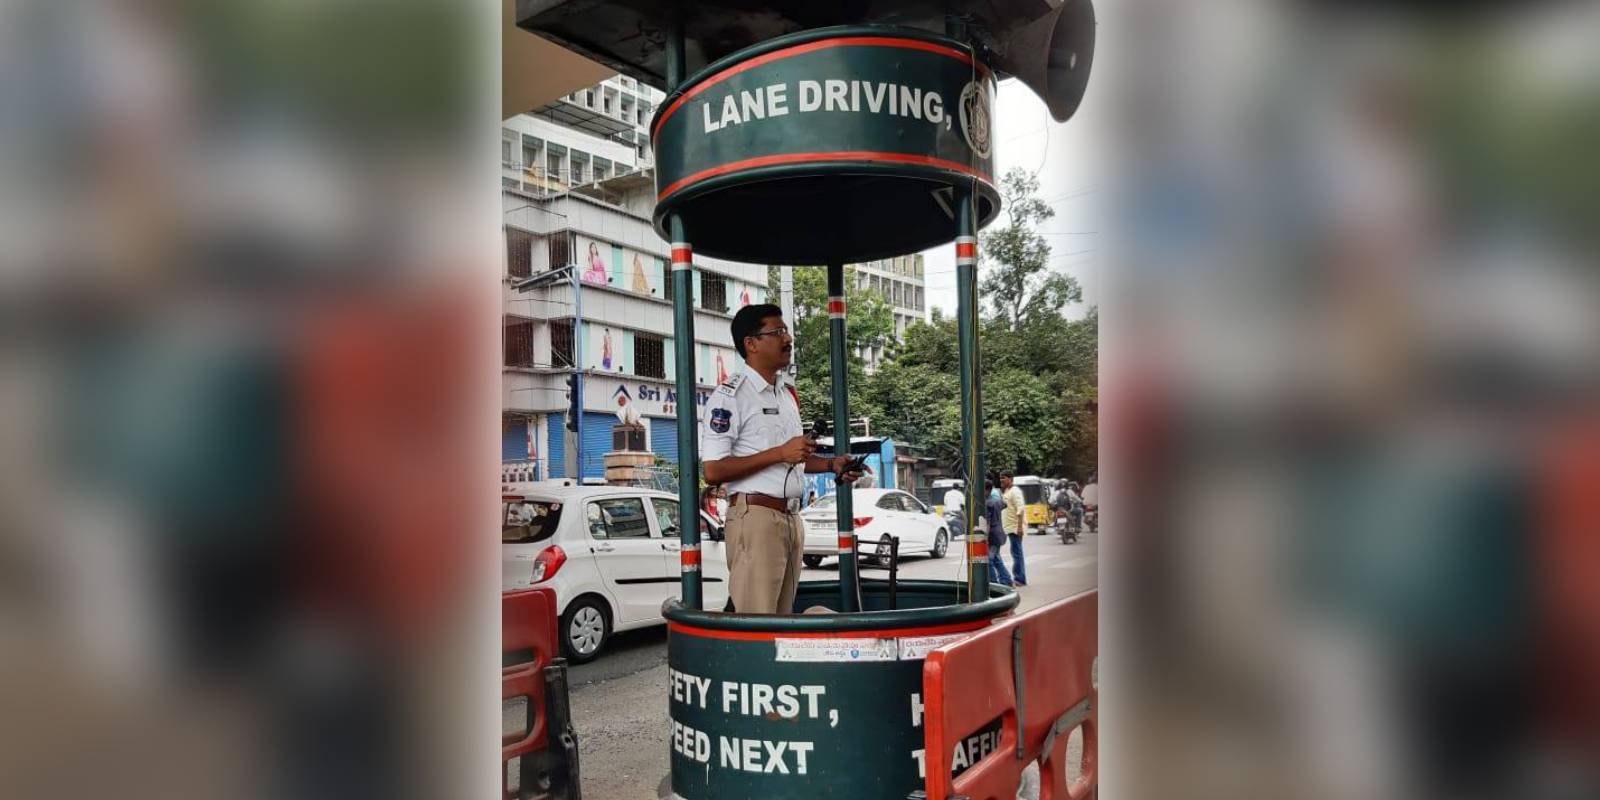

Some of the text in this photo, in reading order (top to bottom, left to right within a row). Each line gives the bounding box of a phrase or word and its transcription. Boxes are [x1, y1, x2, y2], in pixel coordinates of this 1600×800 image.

[702, 83, 789, 134] LANE
[799, 79, 951, 130] DRIVING,
[638, 384, 661, 401] Sri
[721, 681, 839, 728] FIRST,
[719, 735, 814, 774] NEXT
